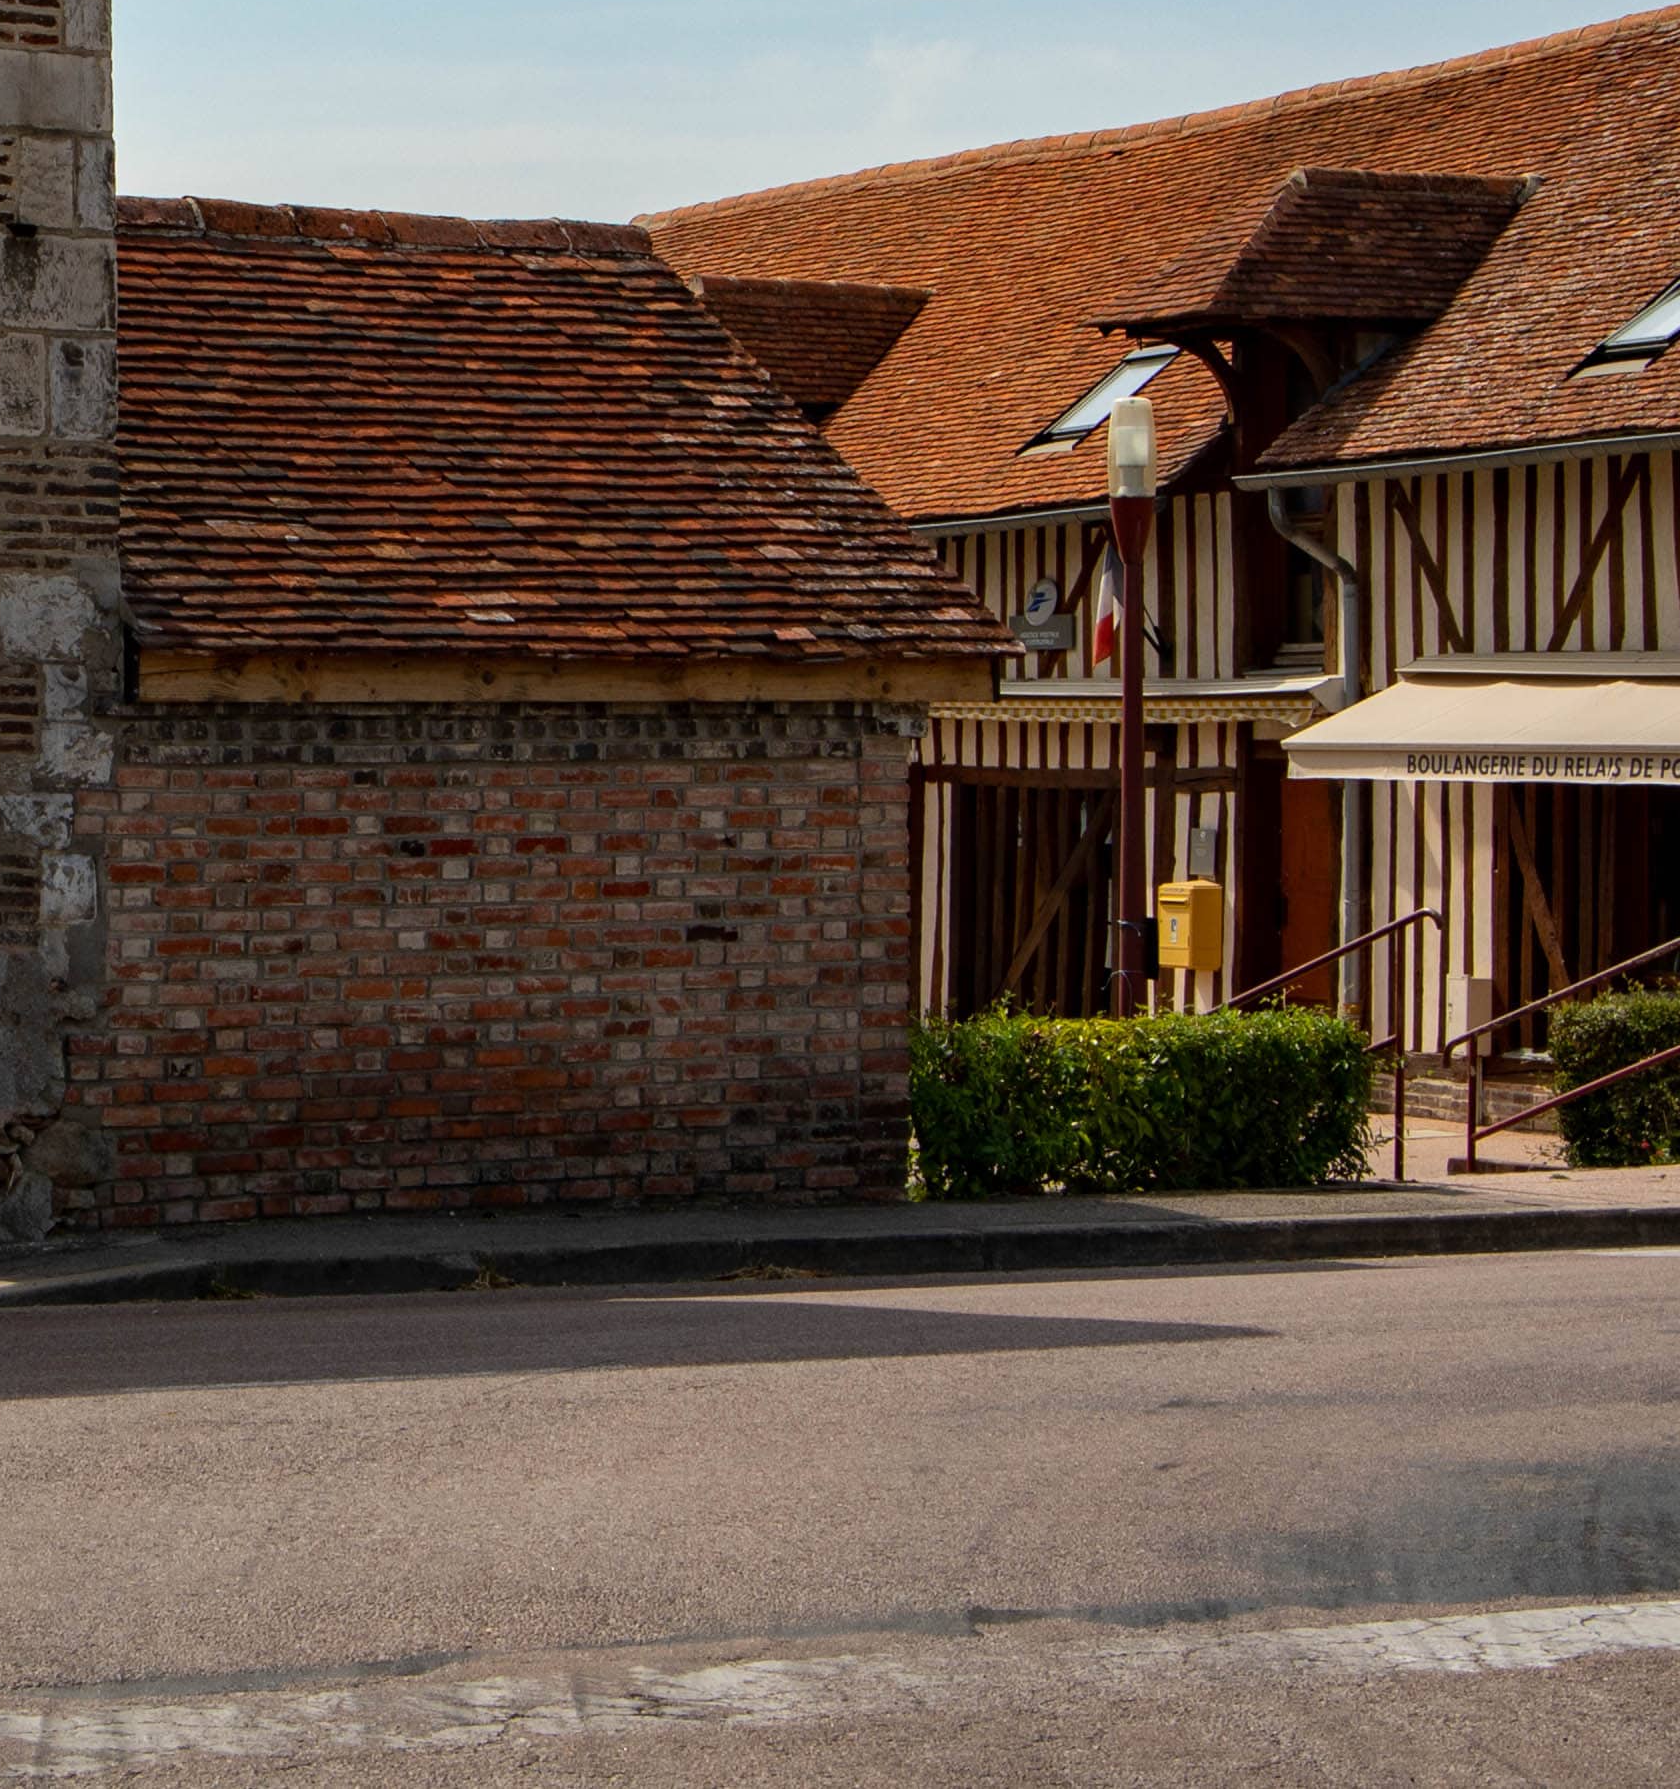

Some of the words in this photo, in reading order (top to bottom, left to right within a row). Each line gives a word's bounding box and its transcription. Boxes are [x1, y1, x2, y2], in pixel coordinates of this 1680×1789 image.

[1406, 754, 1526, 775] BOULANGERIE
[1532, 756, 1557, 776] DU
[1563, 756, 1622, 778] RELAIS
[1629, 758, 1653, 778] DE
